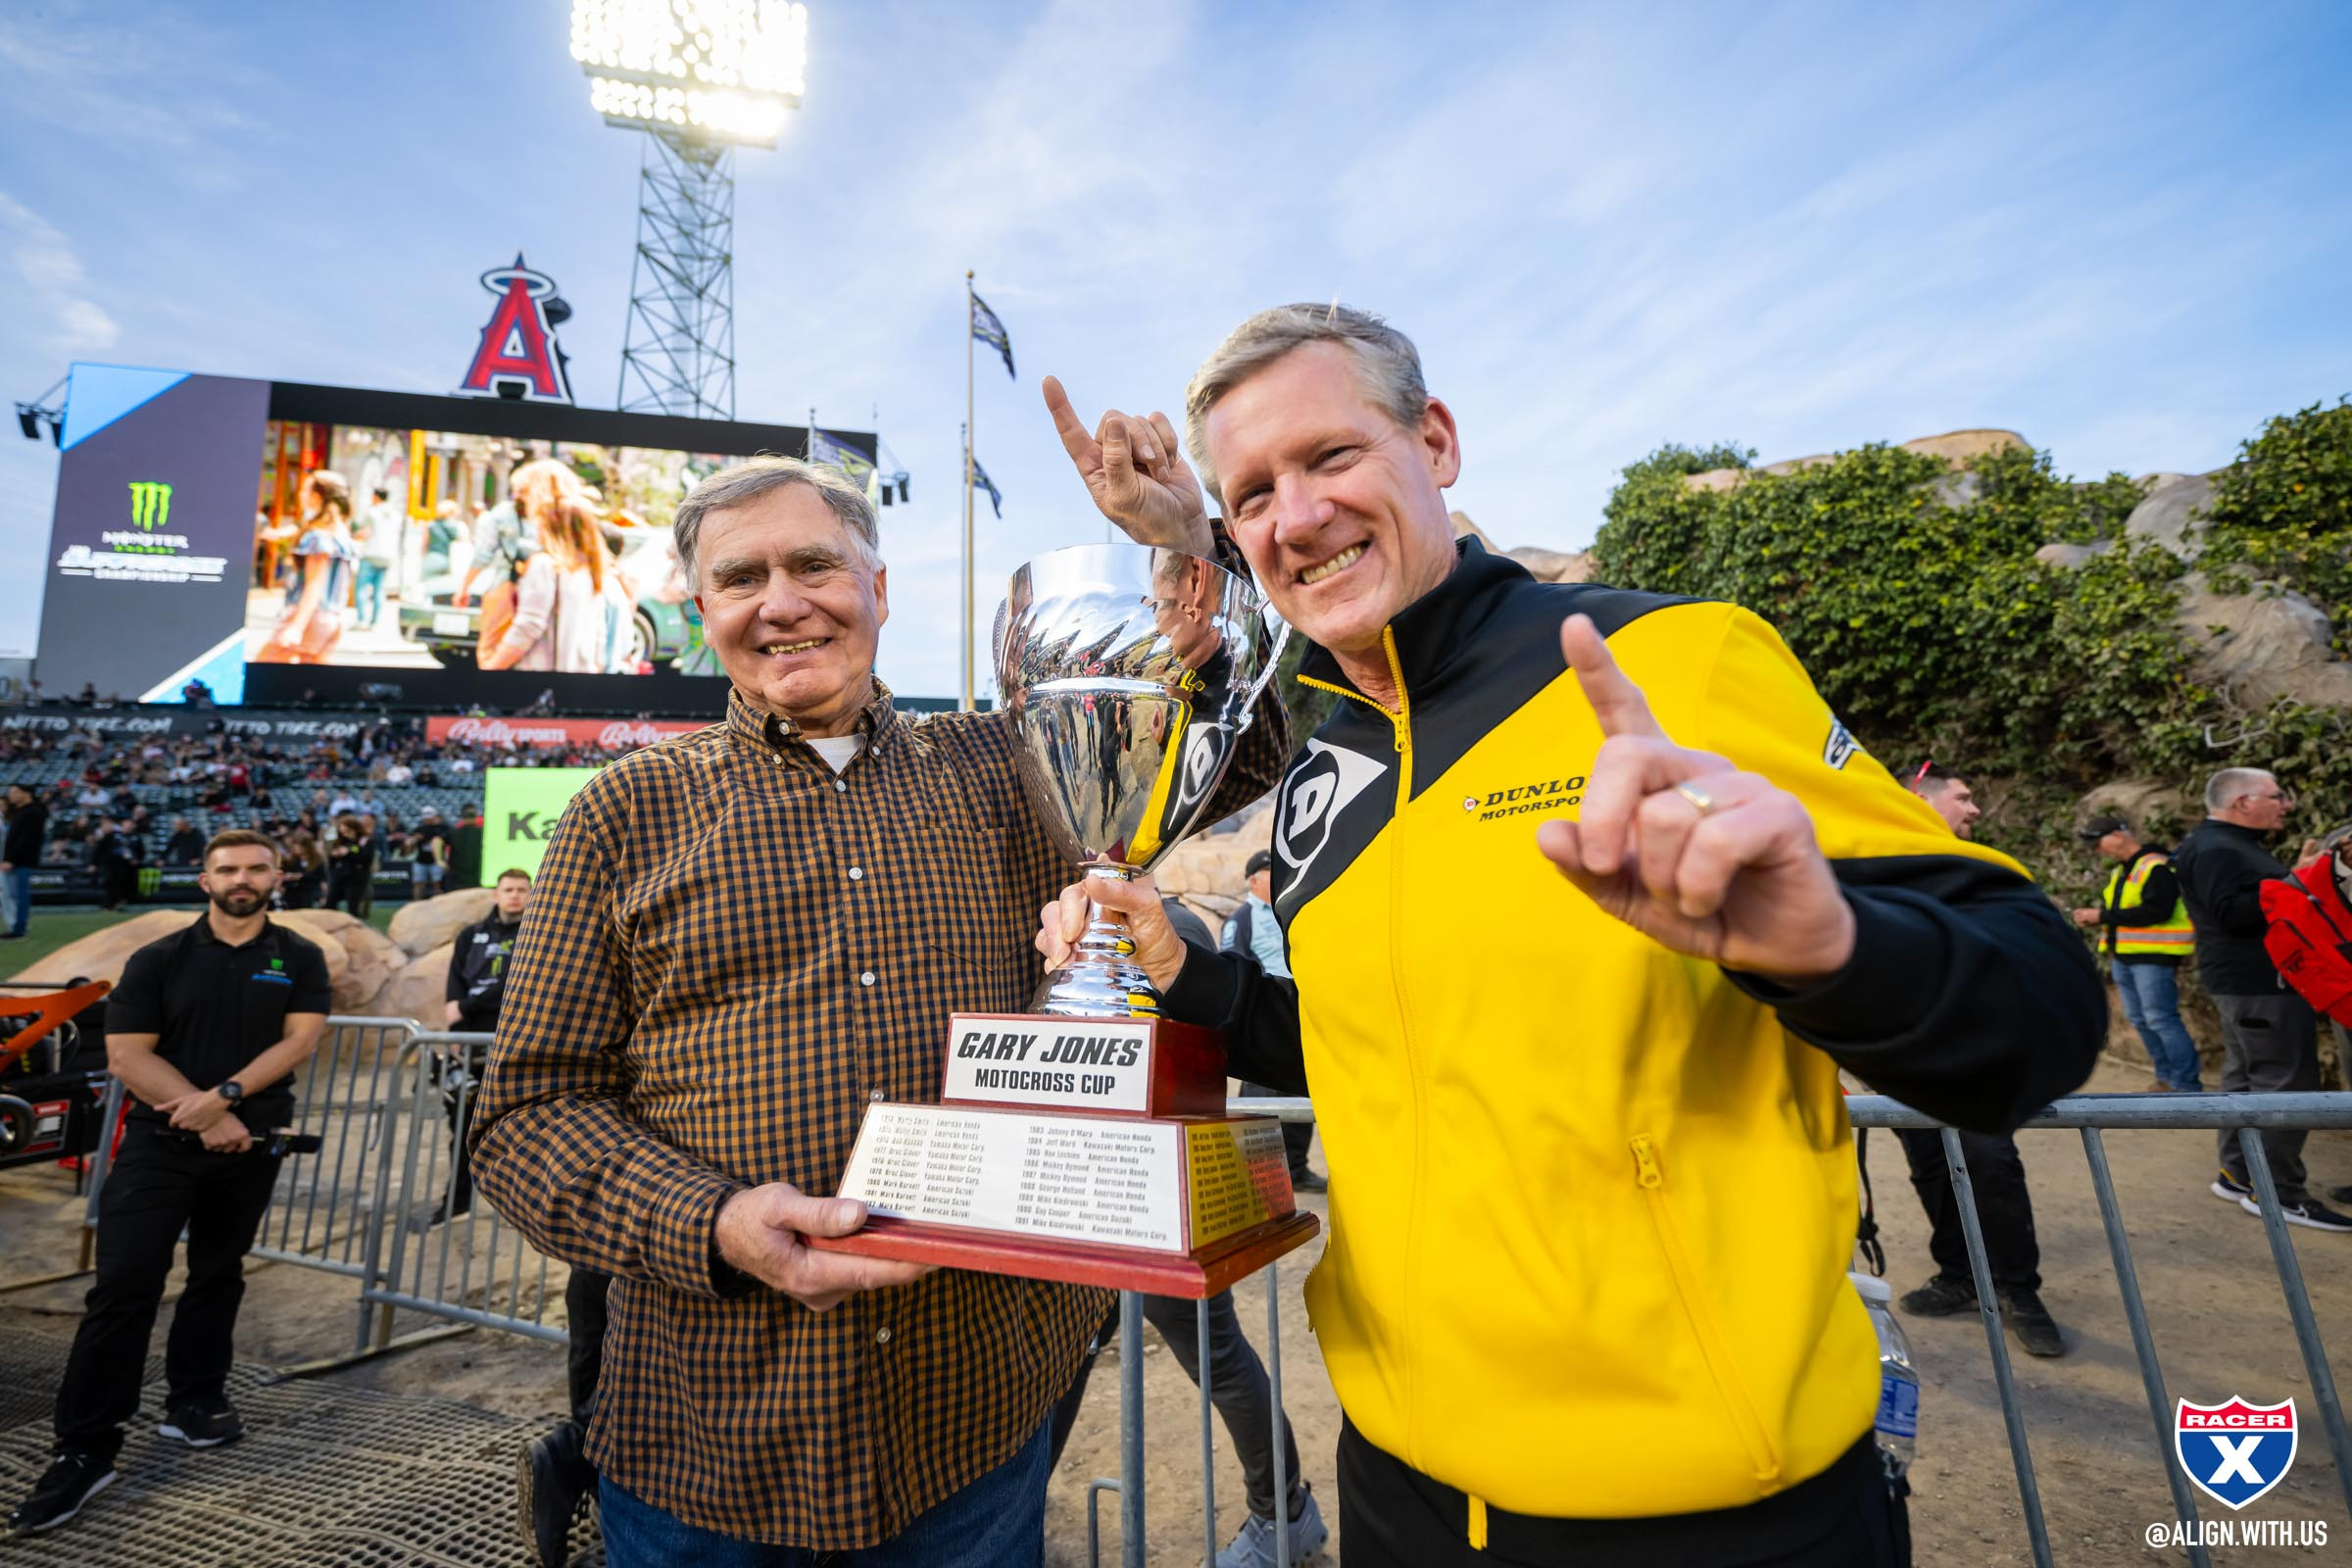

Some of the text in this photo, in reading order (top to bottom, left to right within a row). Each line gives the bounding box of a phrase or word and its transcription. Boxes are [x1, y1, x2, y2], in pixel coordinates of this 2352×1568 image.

[1484, 776, 1586, 807] DUNLO
[1478, 796, 1581, 822] MOTORSPO
[957, 1032, 1144, 1067] GARY JONES
[975, 1068, 1116, 1096] MOTOCROSS CUP
[1101, 1131, 1130, 1141] American
[1084, 1142, 1113, 1151] Kawasaki
[1115, 1144, 1138, 1152] Motors
[1088, 1152, 1117, 1162] American
[1120, 1155, 1139, 1164] Honda
[1043, 1160, 1063, 1170] Mickey
[1098, 1165, 1127, 1175] American
[1129, 1168, 1149, 1177] Honda
[927, 1184, 954, 1193] American
[1040, 1172, 1061, 1182] Mickey
[1095, 1177, 1125, 1187] American
[1127, 1179, 1147, 1189] Honda
[923, 1195, 950, 1204] American
[1094, 1189, 1123, 1199] American
[1126, 1192, 1146, 1201] Honda
[923, 1205, 949, 1215] American
[1037, 1195, 1052, 1203] Mike
[1097, 1200, 1127, 1211] American
[1129, 1204, 1149, 1213] Honda
[1036, 1206, 1047, 1216] Guy
[1078, 1210, 1108, 1222] American
[1032, 1218, 1048, 1227] Mike
[1093, 1225, 1122, 1235] Kawasaki
[1125, 1228, 1148, 1238] Motors
